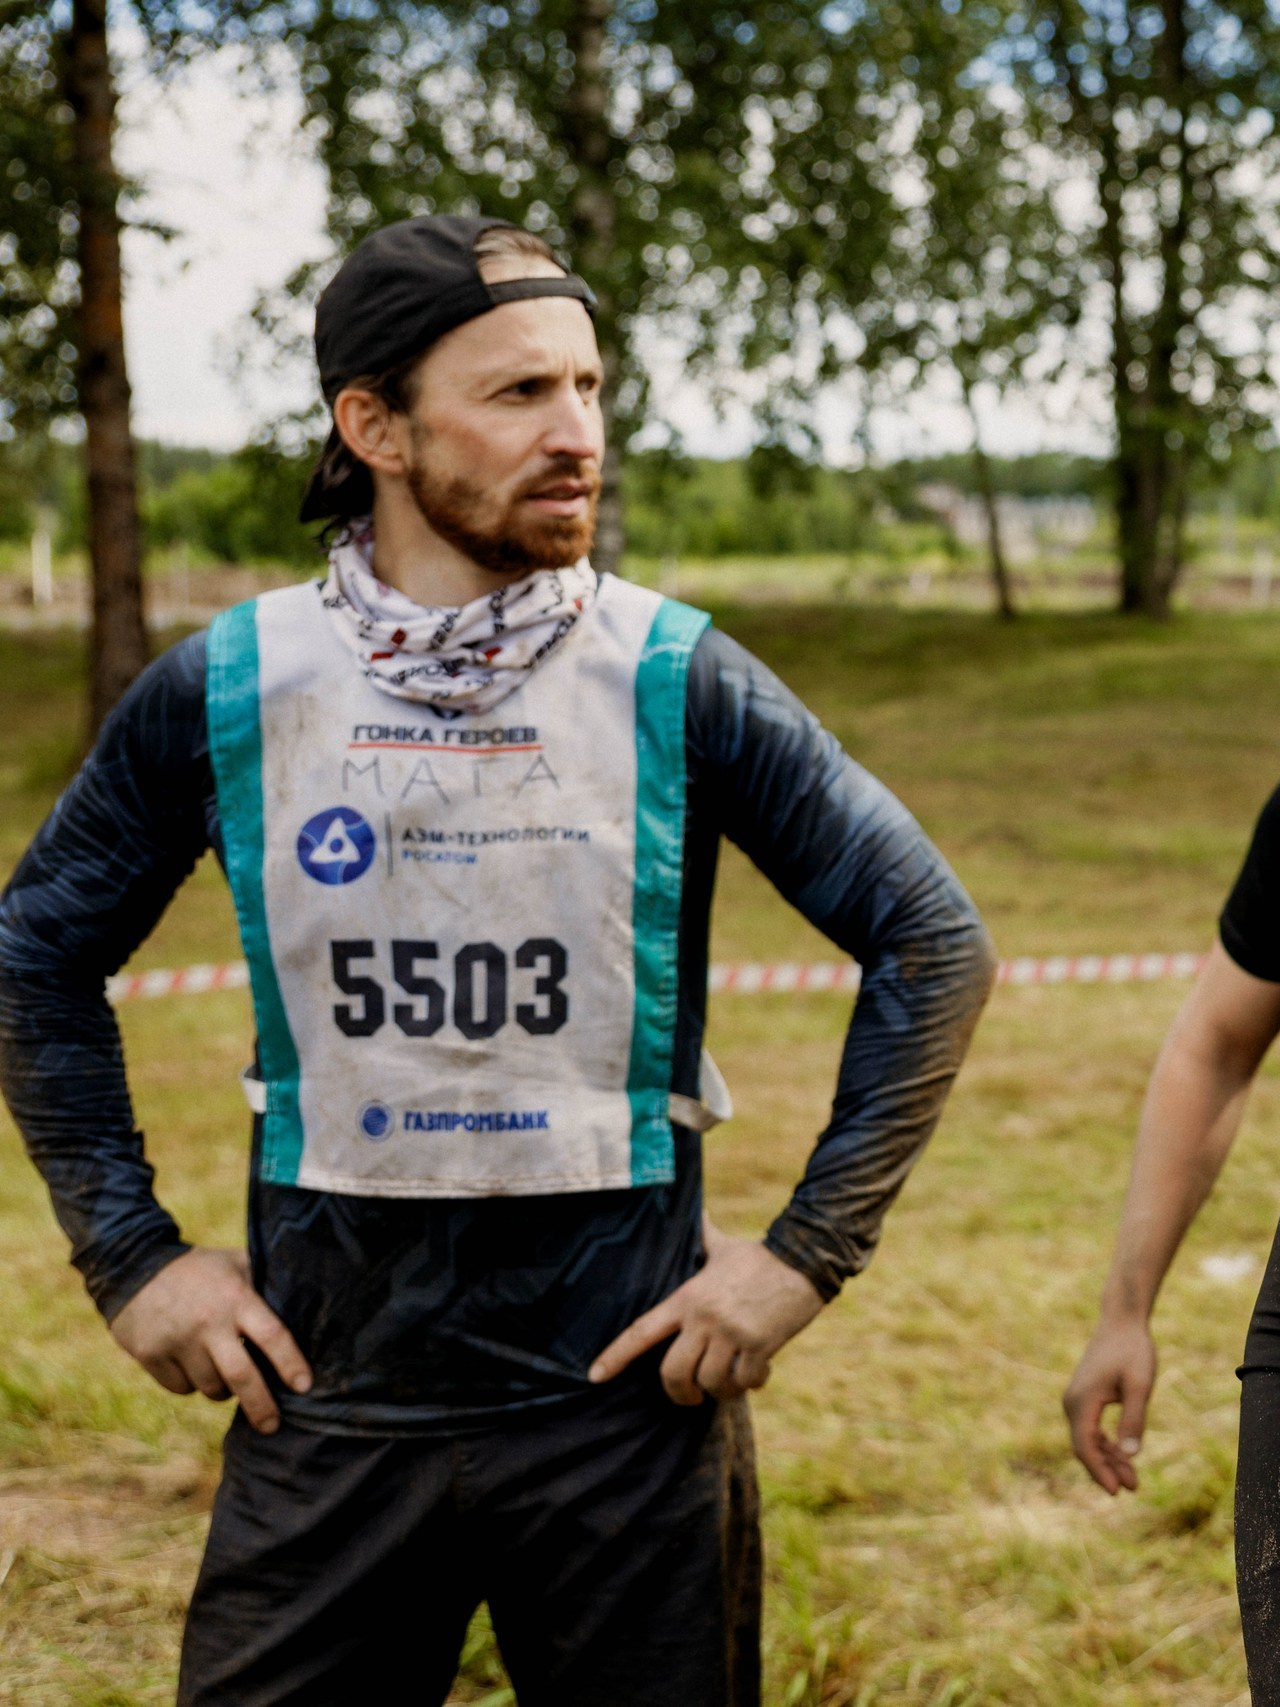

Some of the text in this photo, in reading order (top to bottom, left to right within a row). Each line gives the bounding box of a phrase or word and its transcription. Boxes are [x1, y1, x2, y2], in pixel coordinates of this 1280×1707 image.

[353, 724, 537, 745] ГОНКА ГЕРОЕВ
[341, 753, 561, 804] МАГА
[330, 937, 569, 1041] 5503
[403, 1109, 549, 1133] ГАЗПРОМБАНК
